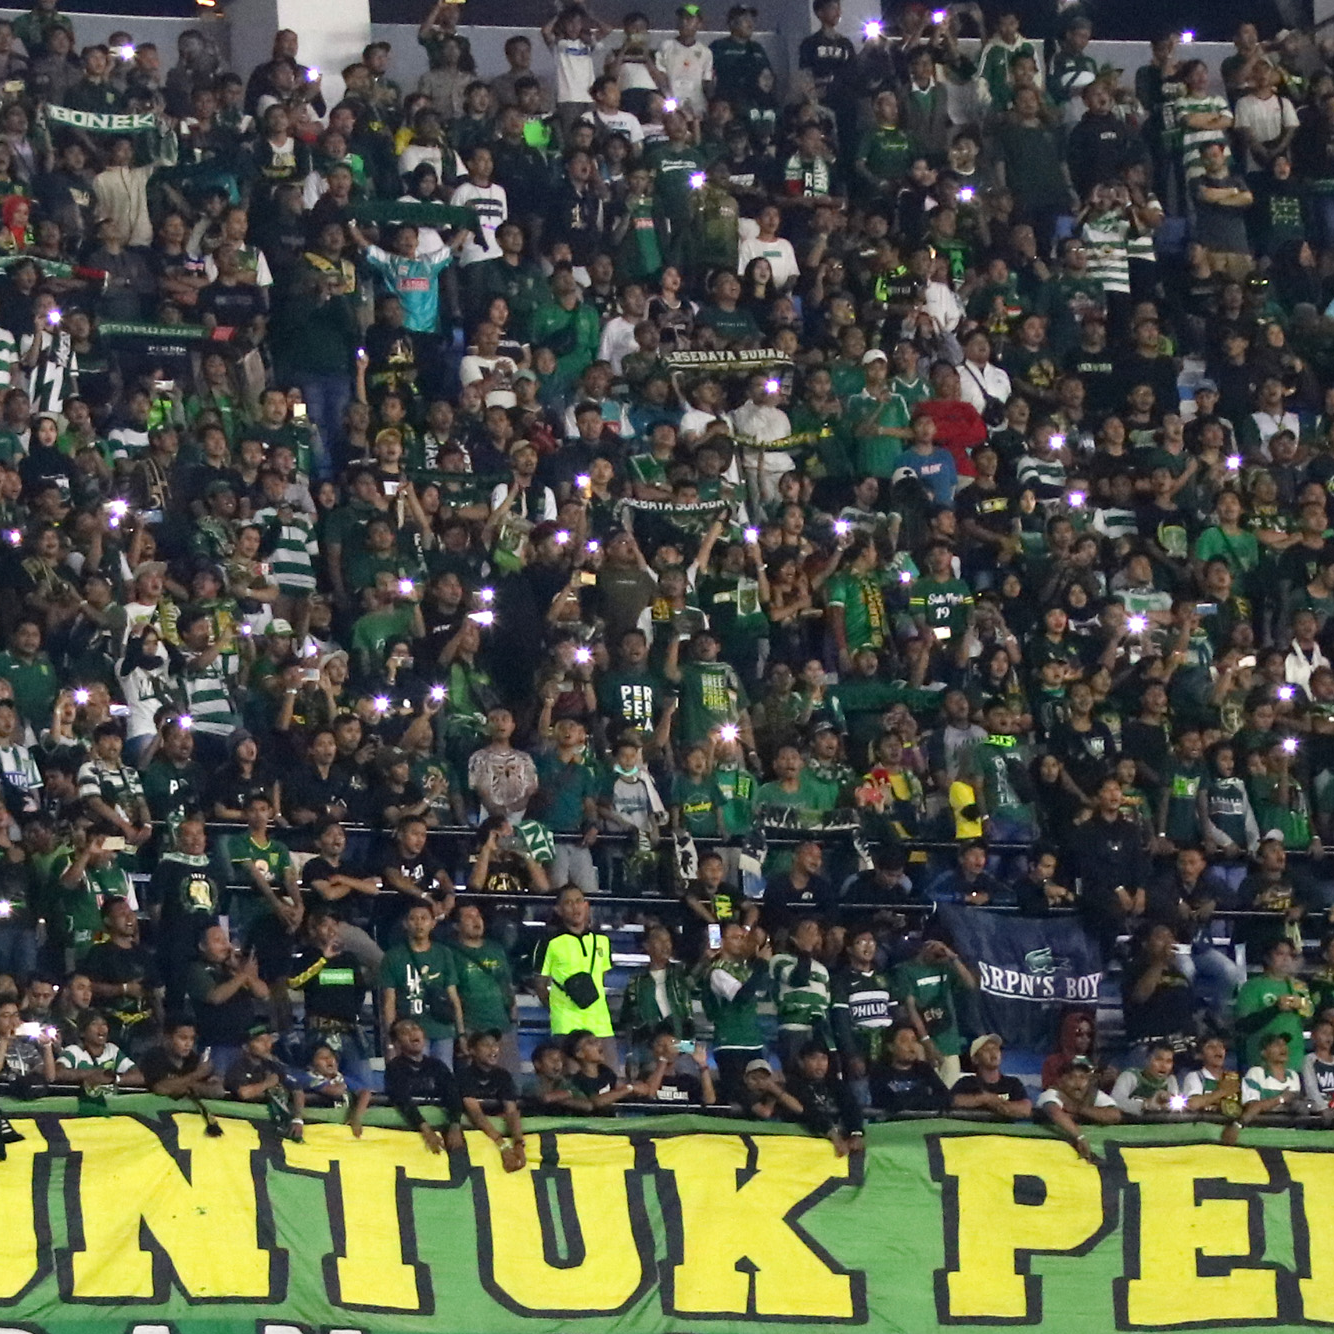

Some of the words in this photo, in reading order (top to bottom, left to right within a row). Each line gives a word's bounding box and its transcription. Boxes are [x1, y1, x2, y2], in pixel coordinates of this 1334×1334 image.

[49, 103, 156, 131] BONEK
[621, 685, 653, 702] PER
[978, 960, 1055, 997] SRPN'S
[1066, 972, 1103, 999] BOY
[852, 1001, 889, 1018] PHILIP
